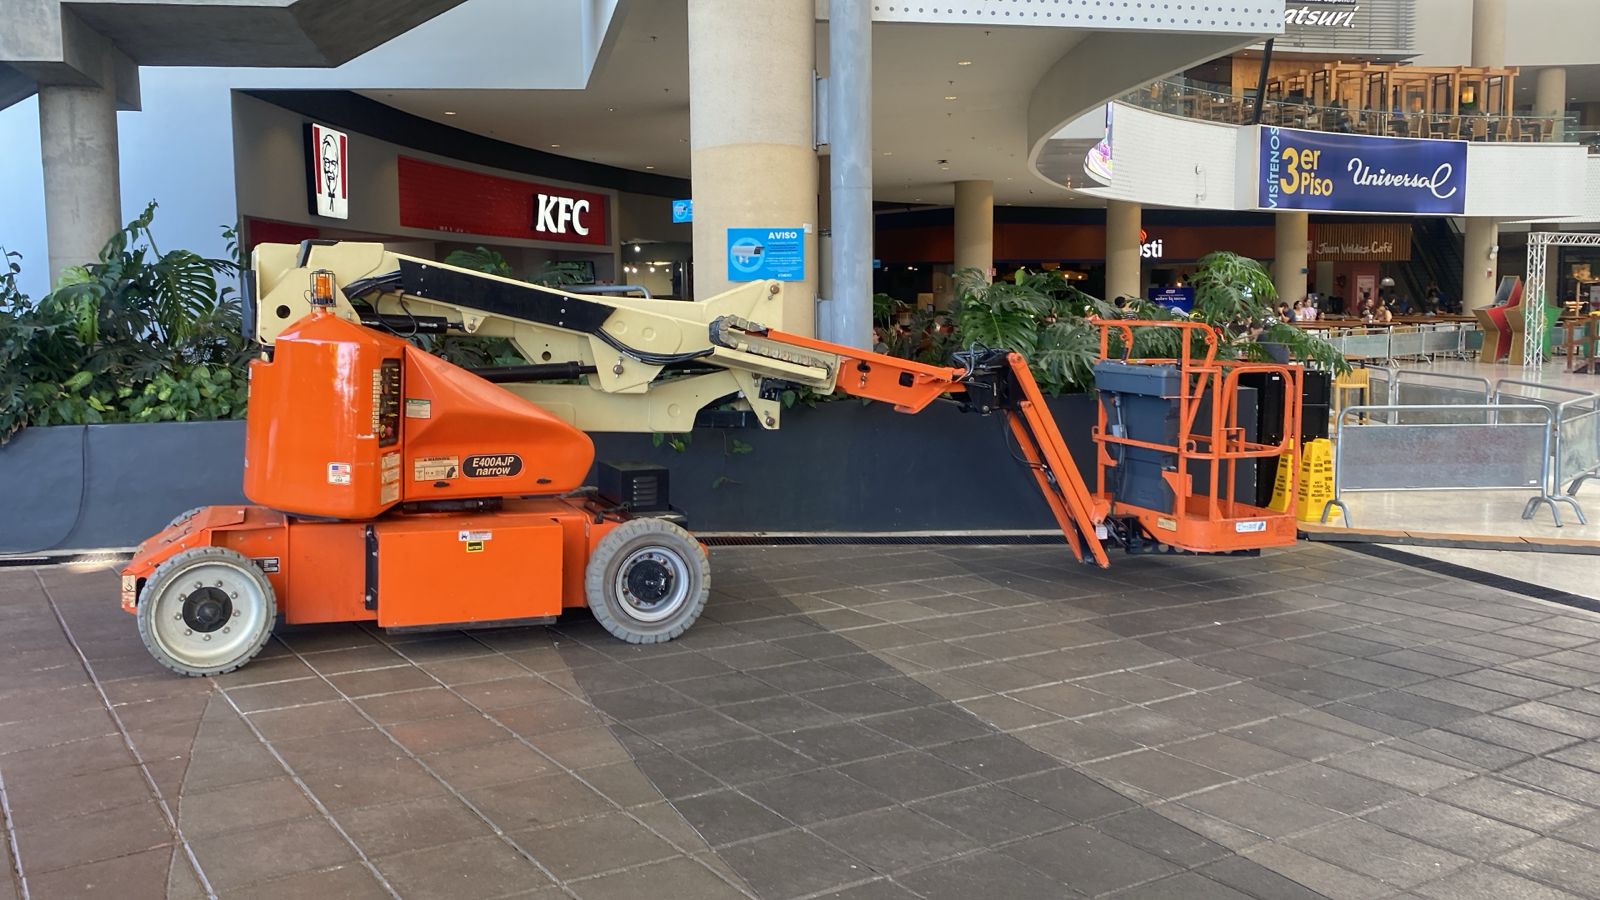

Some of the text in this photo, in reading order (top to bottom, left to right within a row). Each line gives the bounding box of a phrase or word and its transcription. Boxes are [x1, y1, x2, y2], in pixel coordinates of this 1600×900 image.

[1267, 127, 1280, 209] VISÍTENOS
[1300, 172, 1334, 197] Piso
[1347, 157, 1457, 199] Universal
[535, 193, 590, 236] KFC
[767, 231, 798, 240] AVISO
[1316, 242, 1340, 255] Juan
[1340, 242, 1371, 255] Valdez
[1371, 241, 1393, 254] Café
[472, 456, 515, 467] E400AJP
[475, 466, 511, 476] narrow
